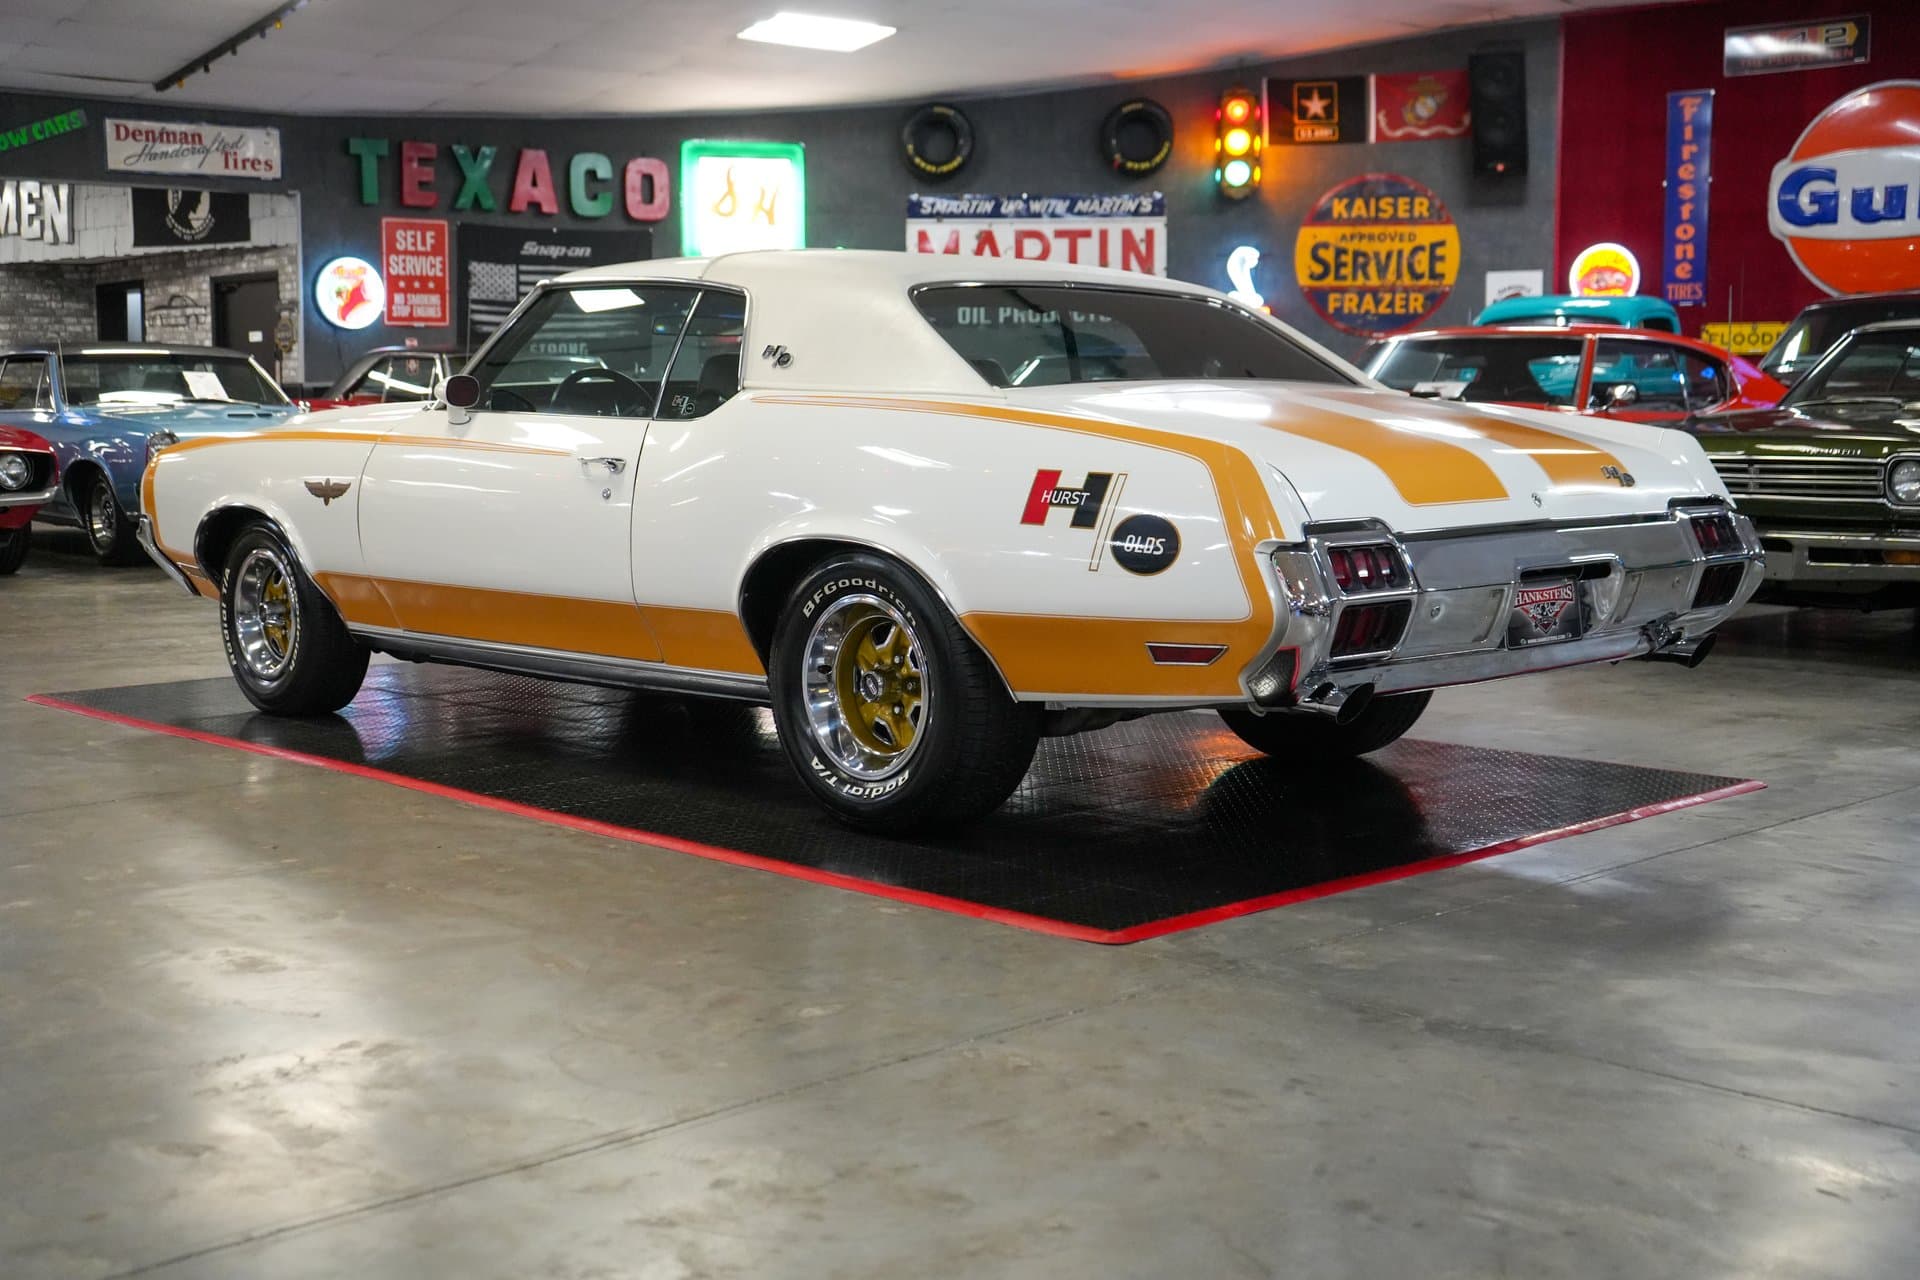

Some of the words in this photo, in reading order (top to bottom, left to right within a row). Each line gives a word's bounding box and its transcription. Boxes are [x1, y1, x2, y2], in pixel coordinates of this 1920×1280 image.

[31, 111, 83, 142] CARS
[114, 123, 204, 146] Denman
[123, 132, 246, 168] Handcrafted
[222, 151, 274, 172] Tires
[348, 137, 671, 221] TEXACO
[1675, 97, 1702, 280] Firestone
[1331, 196, 1430, 219] KAISER
[1778, 166, 1920, 228] Gu
[396, 230, 435, 252] SELF
[1340, 231, 1417, 243] APPROVED
[520, 240, 592, 258] Snap-on
[389, 255, 443, 277] SERVICE
[1309, 240, 1447, 281] SERVICE
[1667, 284, 1702, 300] TIRES
[957, 306, 991, 324] OIL
[1327, 293, 1425, 315] FRAZER
[1041, 490, 1090, 506] HURST
[1124, 534, 1166, 555] OLDS
[803, 578, 917, 628] BFGoodrich
[1514, 585, 1574, 605] HANKSTERS
[843, 769, 910, 799] Radial
